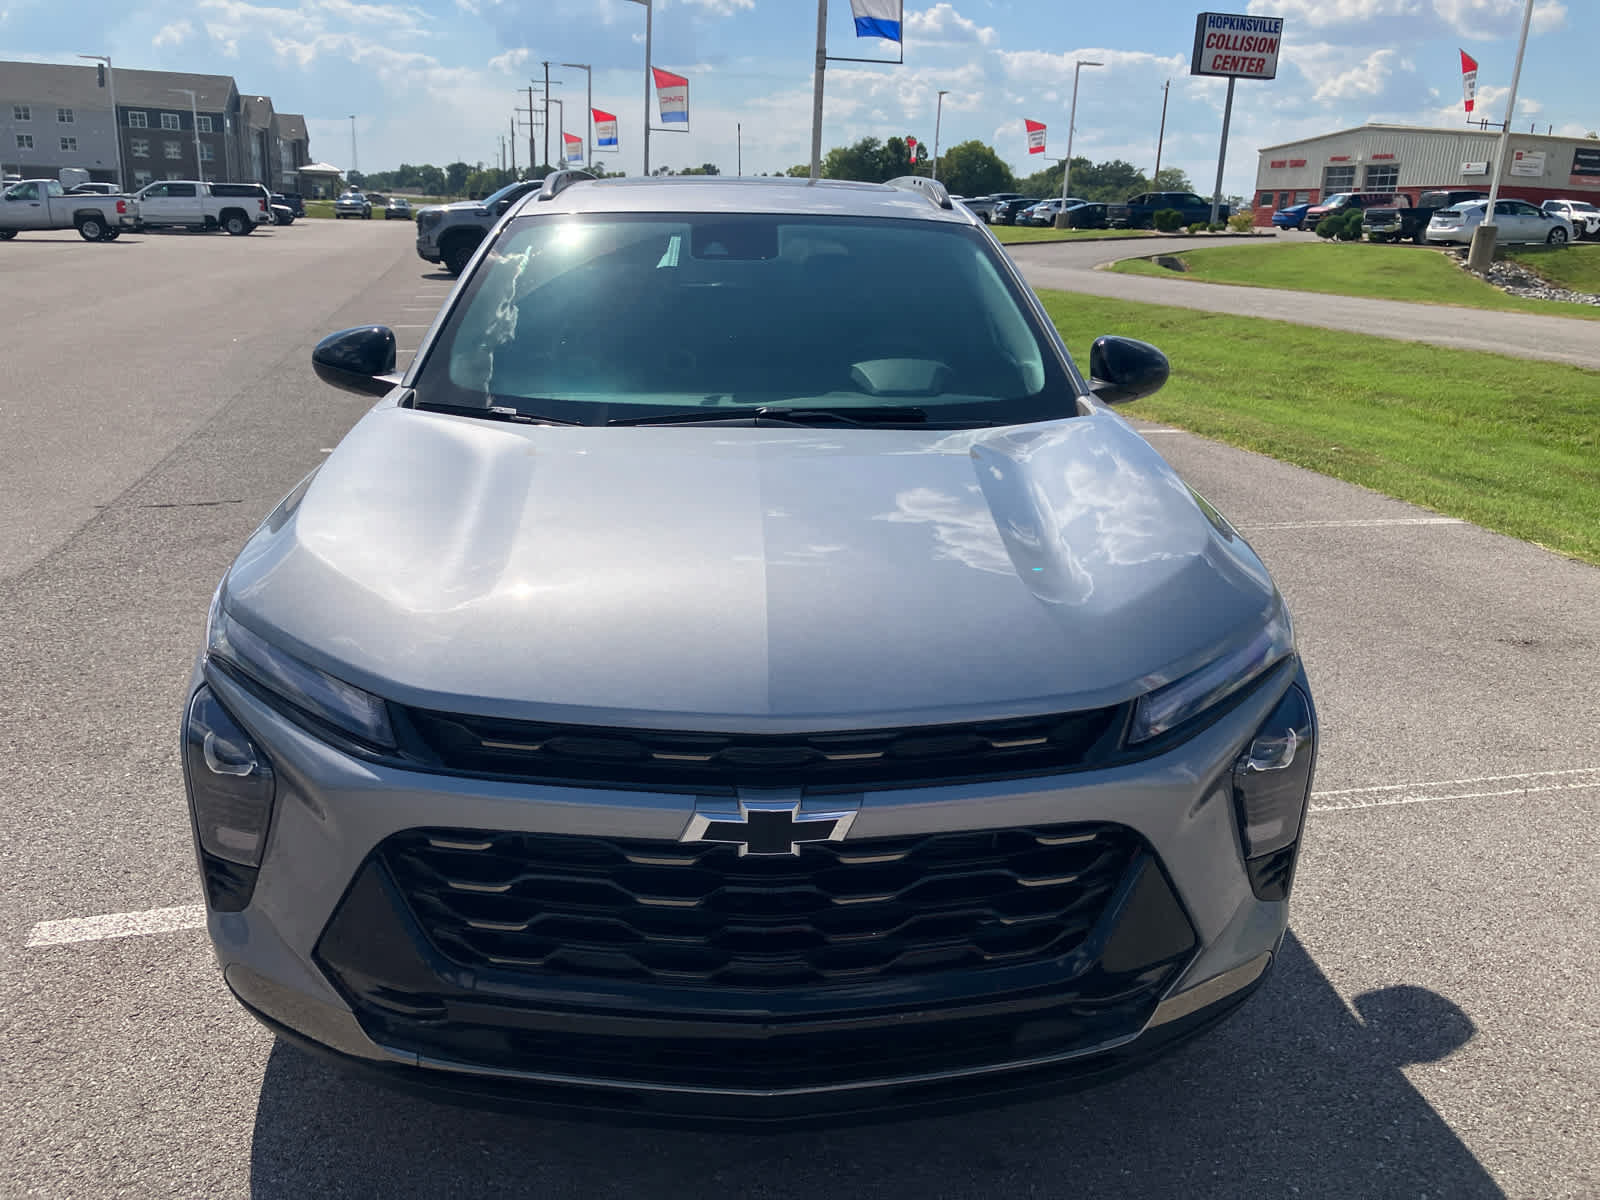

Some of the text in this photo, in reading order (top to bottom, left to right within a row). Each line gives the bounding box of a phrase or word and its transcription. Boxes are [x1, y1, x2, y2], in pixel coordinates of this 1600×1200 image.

[1208, 16, 1280, 33] HOPKINSVILLE
[1206, 33, 1277, 54] COLLISION
[1212, 54, 1265, 73] CENTER
